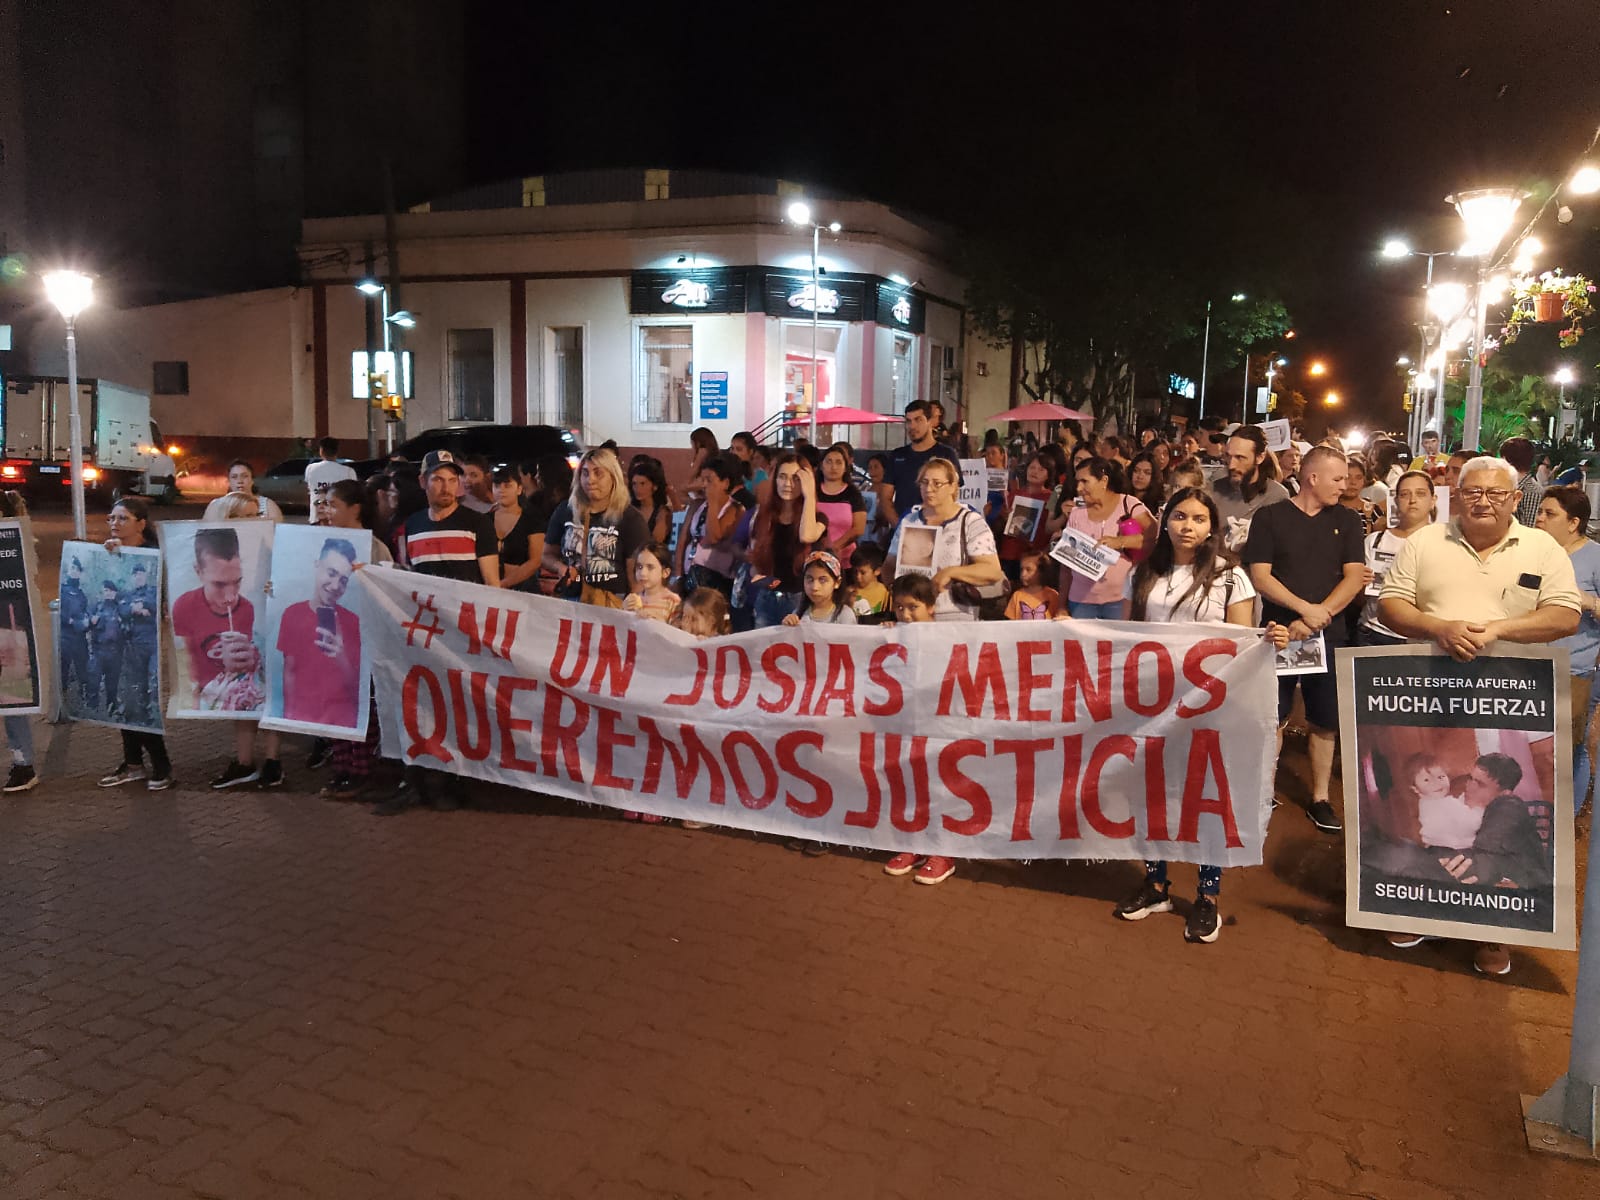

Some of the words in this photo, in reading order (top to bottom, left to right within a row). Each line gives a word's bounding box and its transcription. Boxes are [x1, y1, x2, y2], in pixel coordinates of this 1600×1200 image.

[0, 579, 23, 589] NOS
[549, 618, 637, 698] UN
[663, 642, 908, 717] JOSIAS
[936, 638, 1238, 722] MENOS
[1373, 676, 1404, 687] ELLA
[1406, 677, 1422, 688] TE
[1424, 677, 1474, 689] ESPERA
[1475, 678, 1537, 690] AFUERA!!
[1367, 695, 1444, 714] MUCHA
[1449, 697, 1547, 717] FUERZA!
[402, 664, 834, 818] QUEREMOS
[844, 728, 1244, 848] JUSTICIA
[1374, 883, 1425, 902] SEGUÍ
[1428, 888, 1536, 913] LUCHANDO!!
